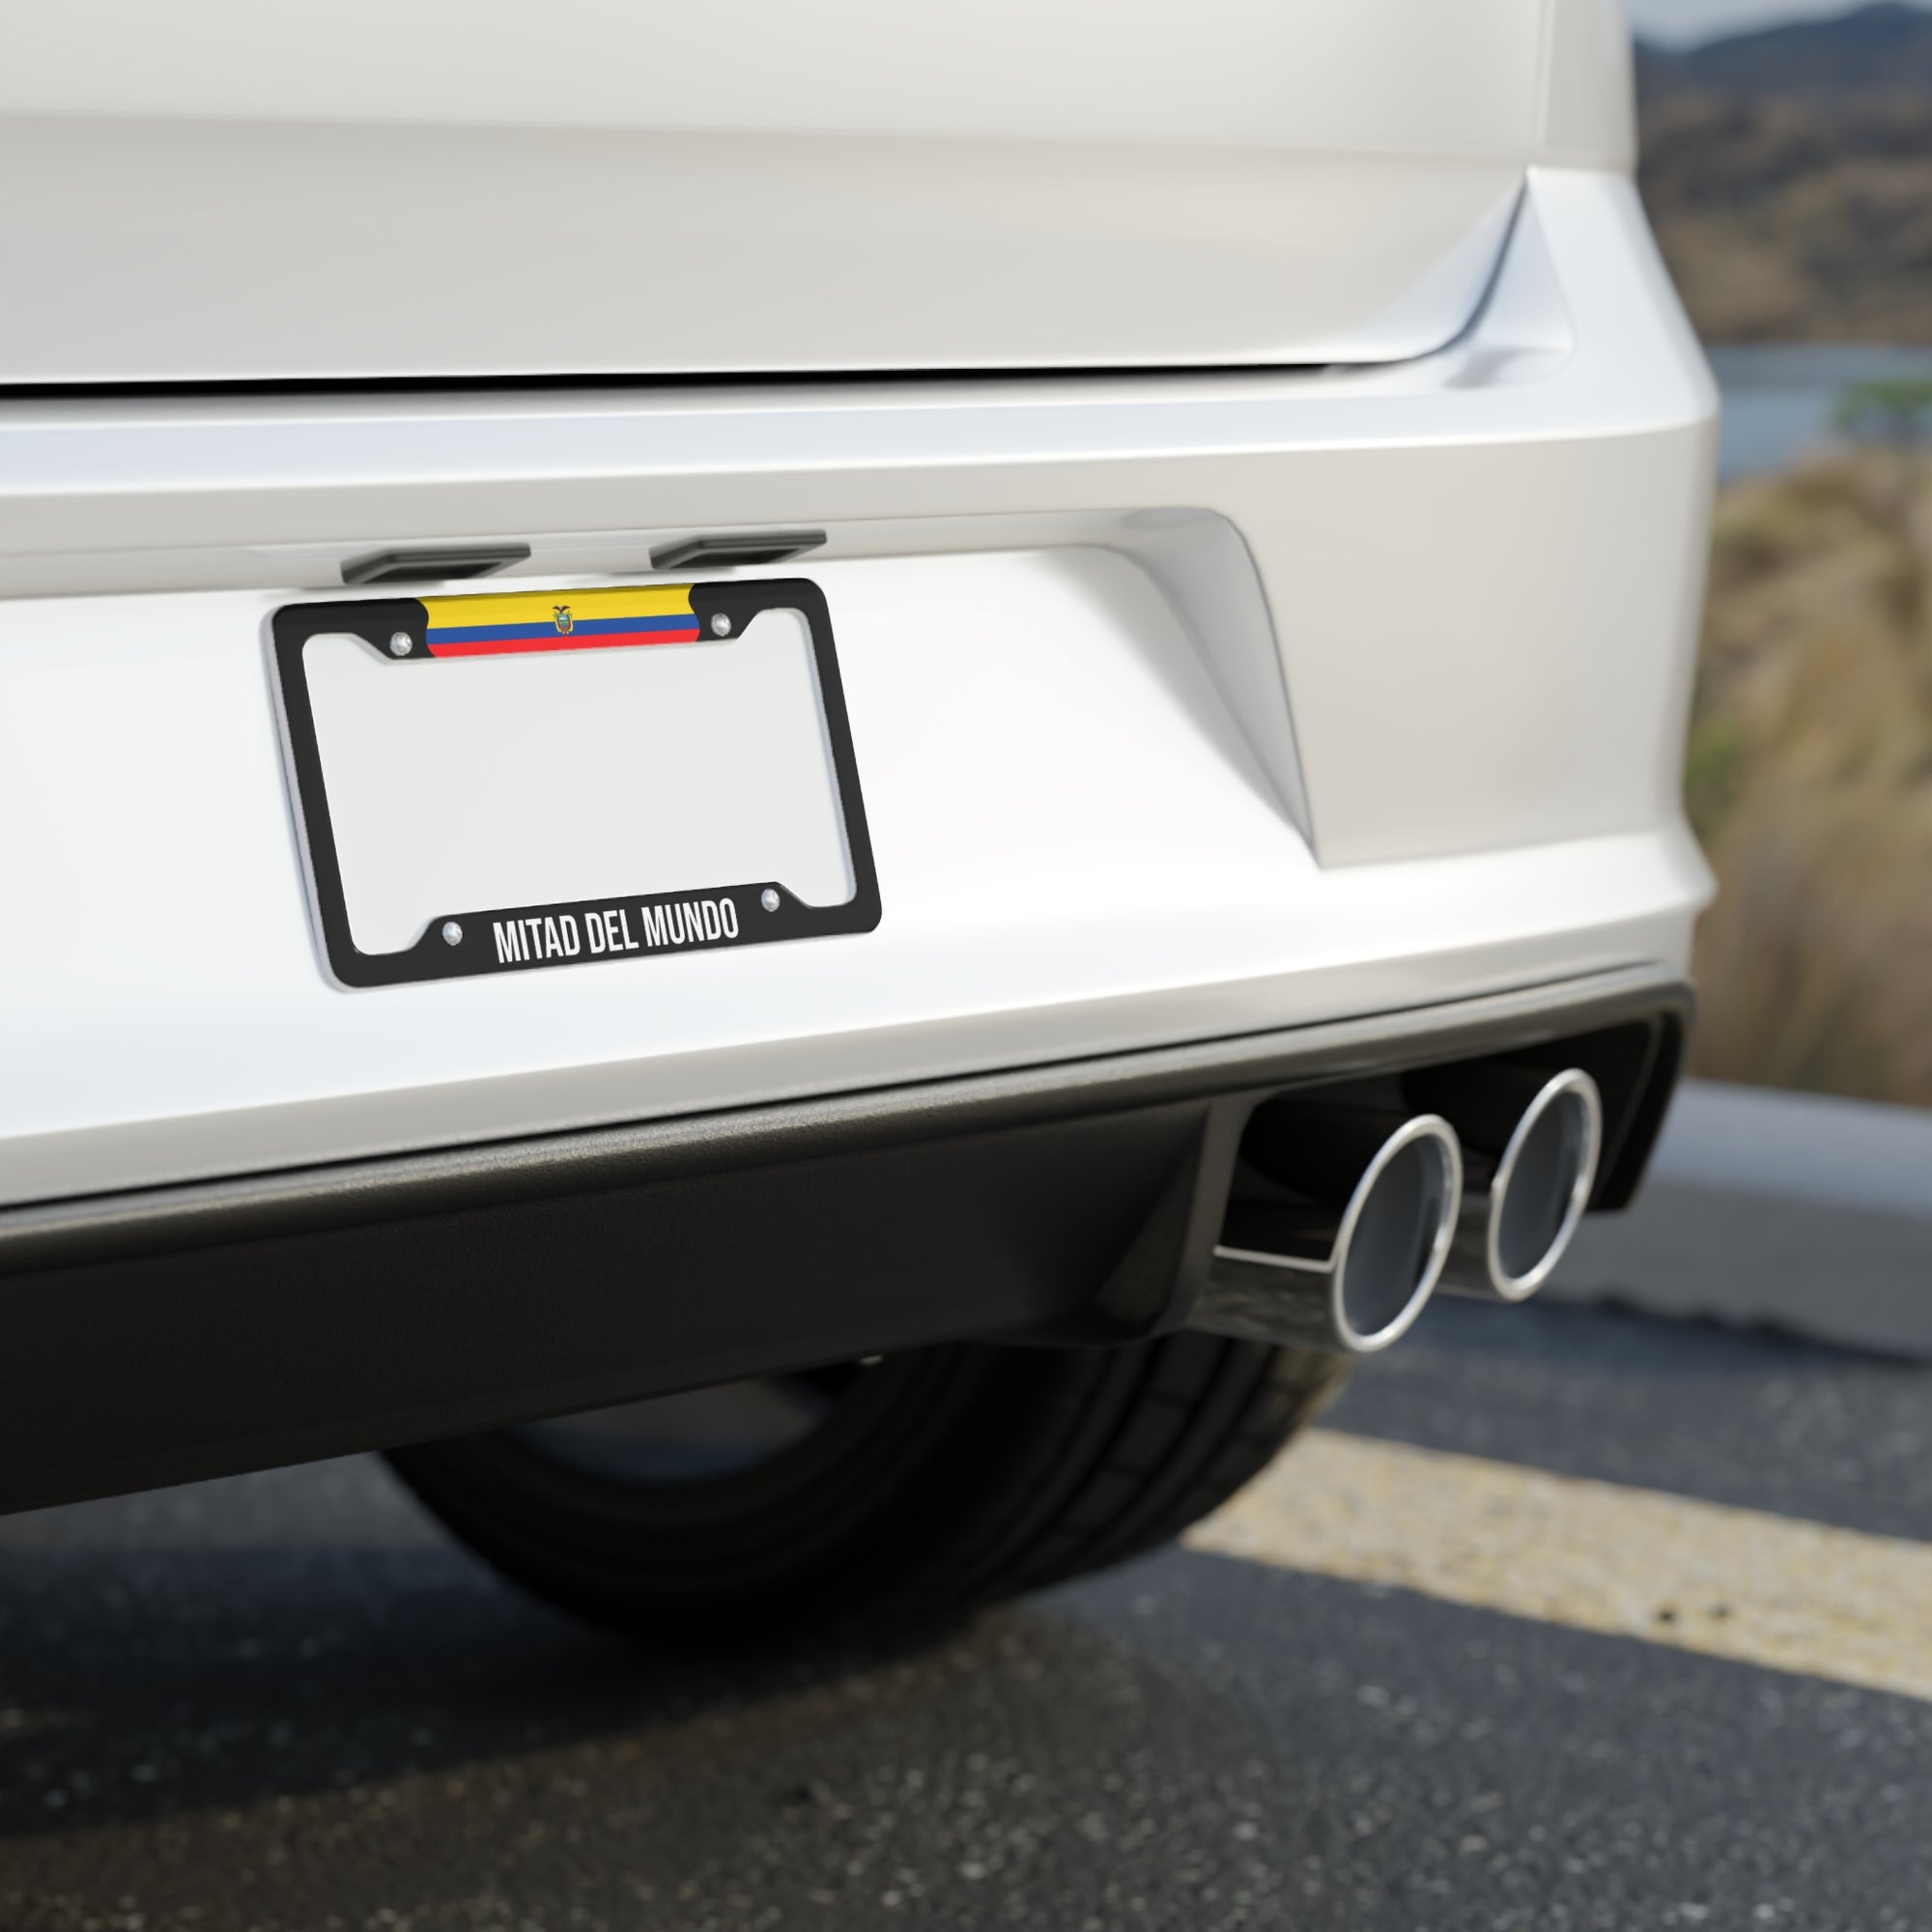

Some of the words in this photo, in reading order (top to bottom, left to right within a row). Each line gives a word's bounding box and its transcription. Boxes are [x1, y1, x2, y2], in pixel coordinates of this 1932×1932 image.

[493, 914, 581, 963] MITAD
[584, 909, 639, 953] DEL
[641, 897, 739, 947] MUNDO
